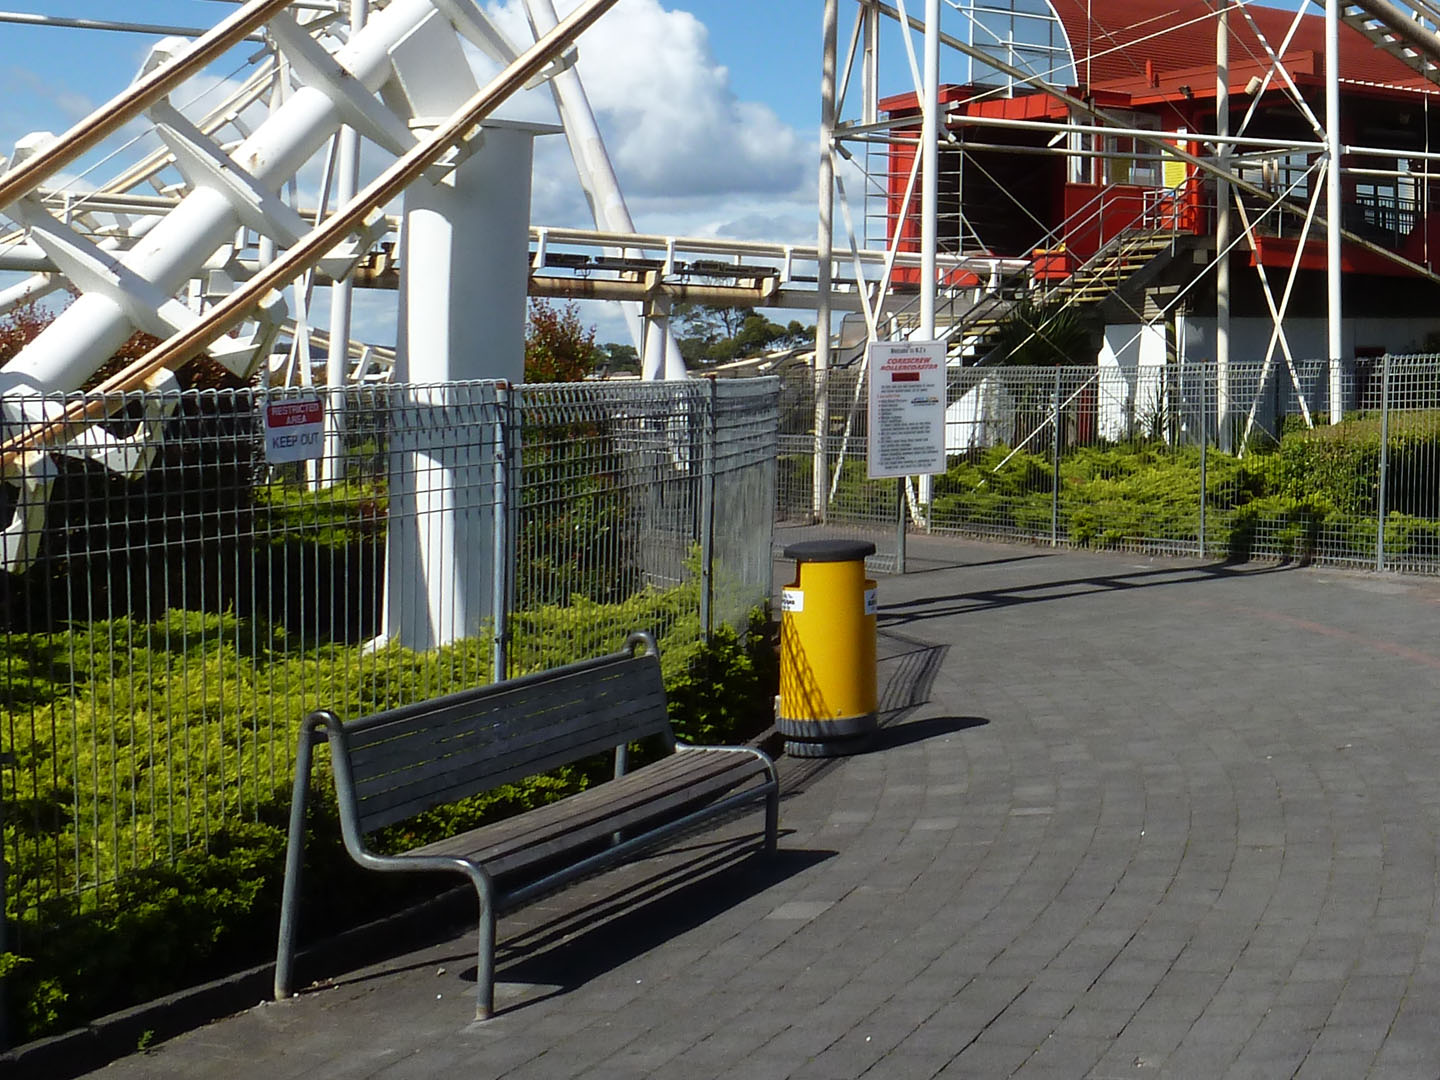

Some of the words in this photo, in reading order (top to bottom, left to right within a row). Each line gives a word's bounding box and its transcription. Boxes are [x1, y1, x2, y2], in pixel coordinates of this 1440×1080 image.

[272, 404, 318, 415] RESTRICTED
[286, 415, 307, 424] AREA
[273, 435, 297, 449] KEEP
[301, 432, 319, 445] OUT
